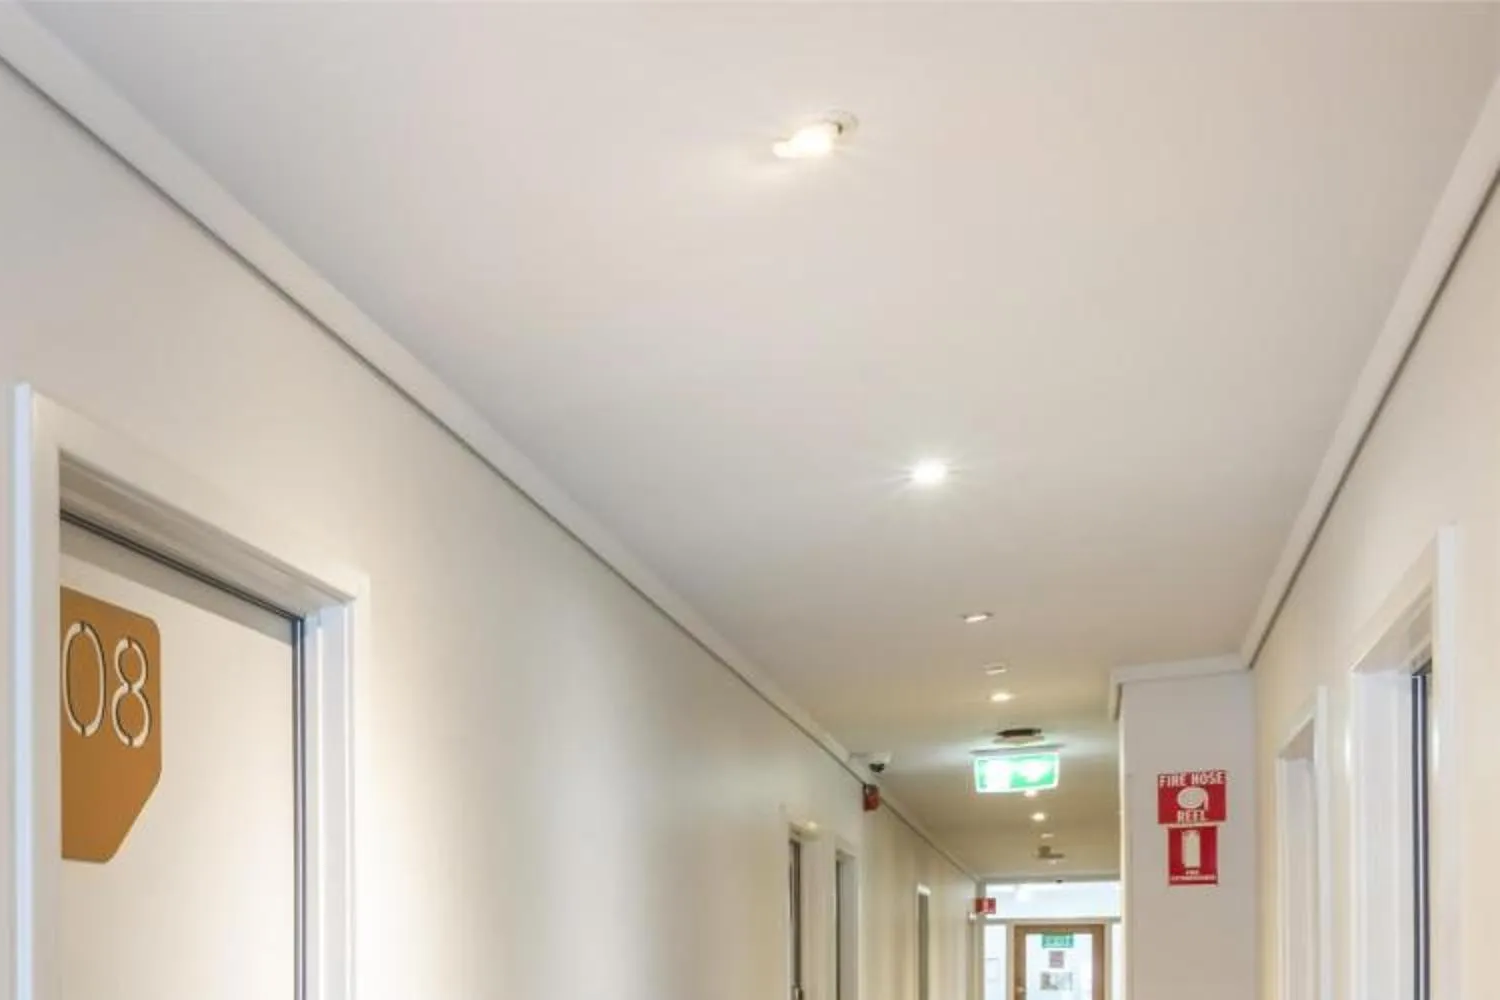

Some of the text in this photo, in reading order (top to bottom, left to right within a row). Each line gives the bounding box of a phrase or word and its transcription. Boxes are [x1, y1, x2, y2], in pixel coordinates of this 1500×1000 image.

[61, 621, 151, 748] 08
[1159, 770, 1224, 788] FIRE HOSE
[1177, 809, 1206, 823] REEL
